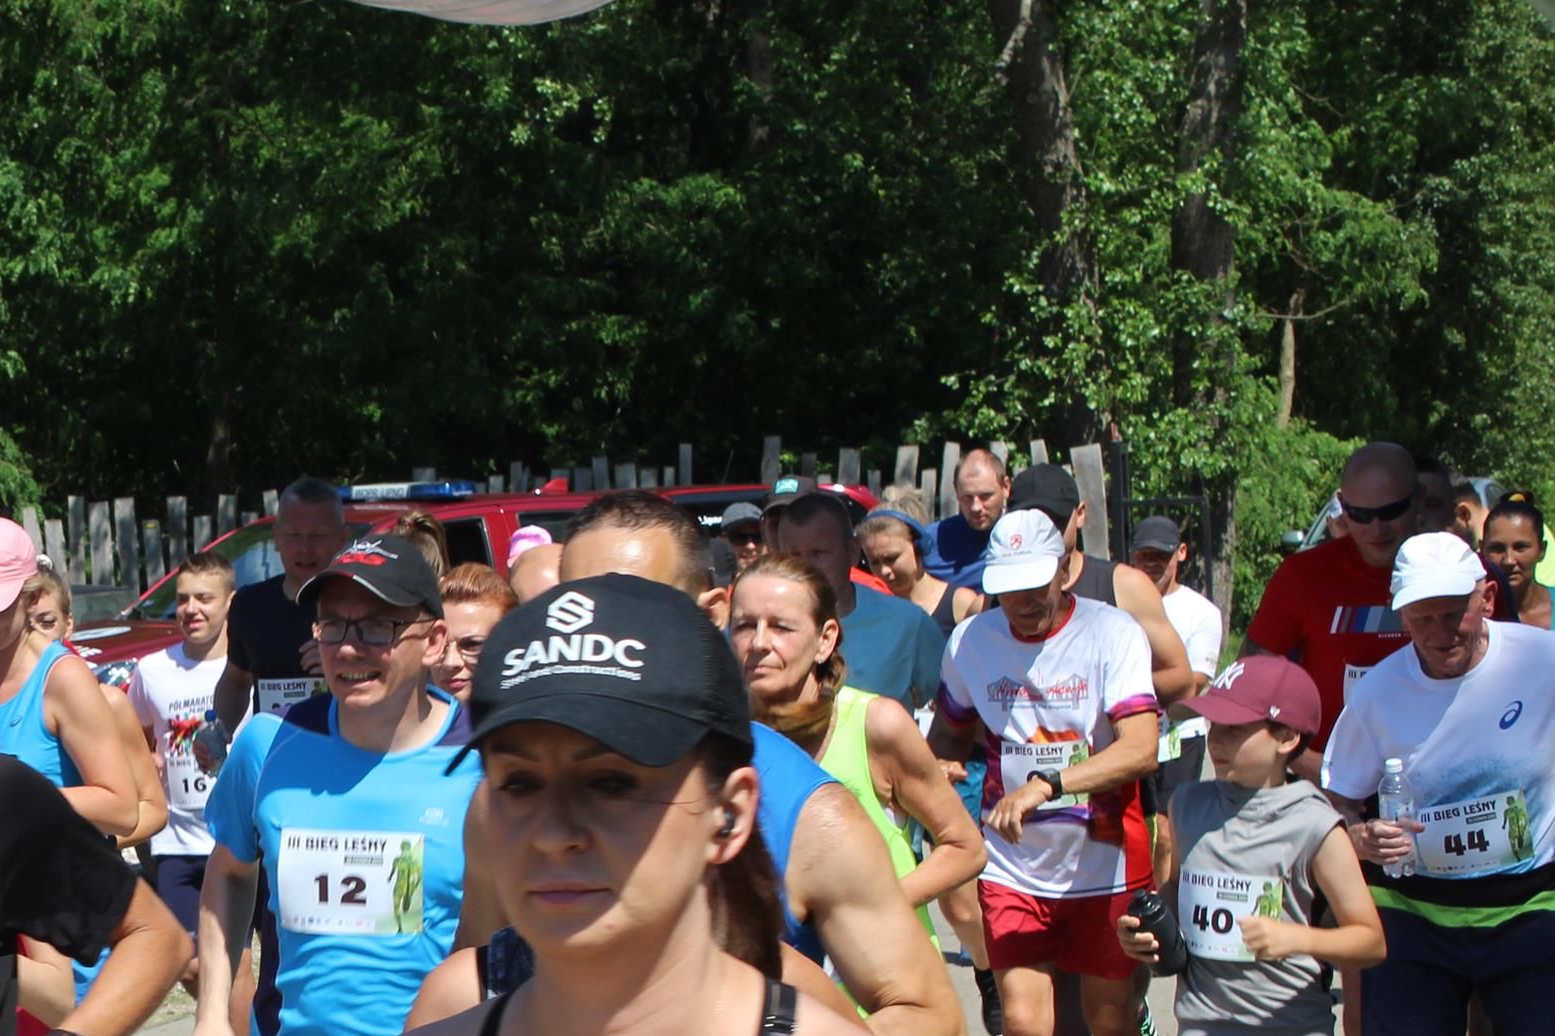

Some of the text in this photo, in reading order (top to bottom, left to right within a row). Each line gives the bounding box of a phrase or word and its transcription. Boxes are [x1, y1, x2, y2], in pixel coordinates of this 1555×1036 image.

[501, 633, 647, 677] SANDC
[1014, 748, 1033, 756] BIEG
[1035, 745, 1064, 756] LEŚNY
[181, 777, 208, 794] 16
[1420, 813, 1431, 824] III
[1433, 808, 1461, 822] BIEG
[1463, 799, 1497, 815] LEŚNY
[287, 835, 388, 854] III BIEG LEŚNY
[1444, 827, 1490, 857] 44
[314, 872, 368, 905] 12
[1182, 871, 1252, 892] III BIEG LEŚNY
[1192, 903, 1235, 935] 40
